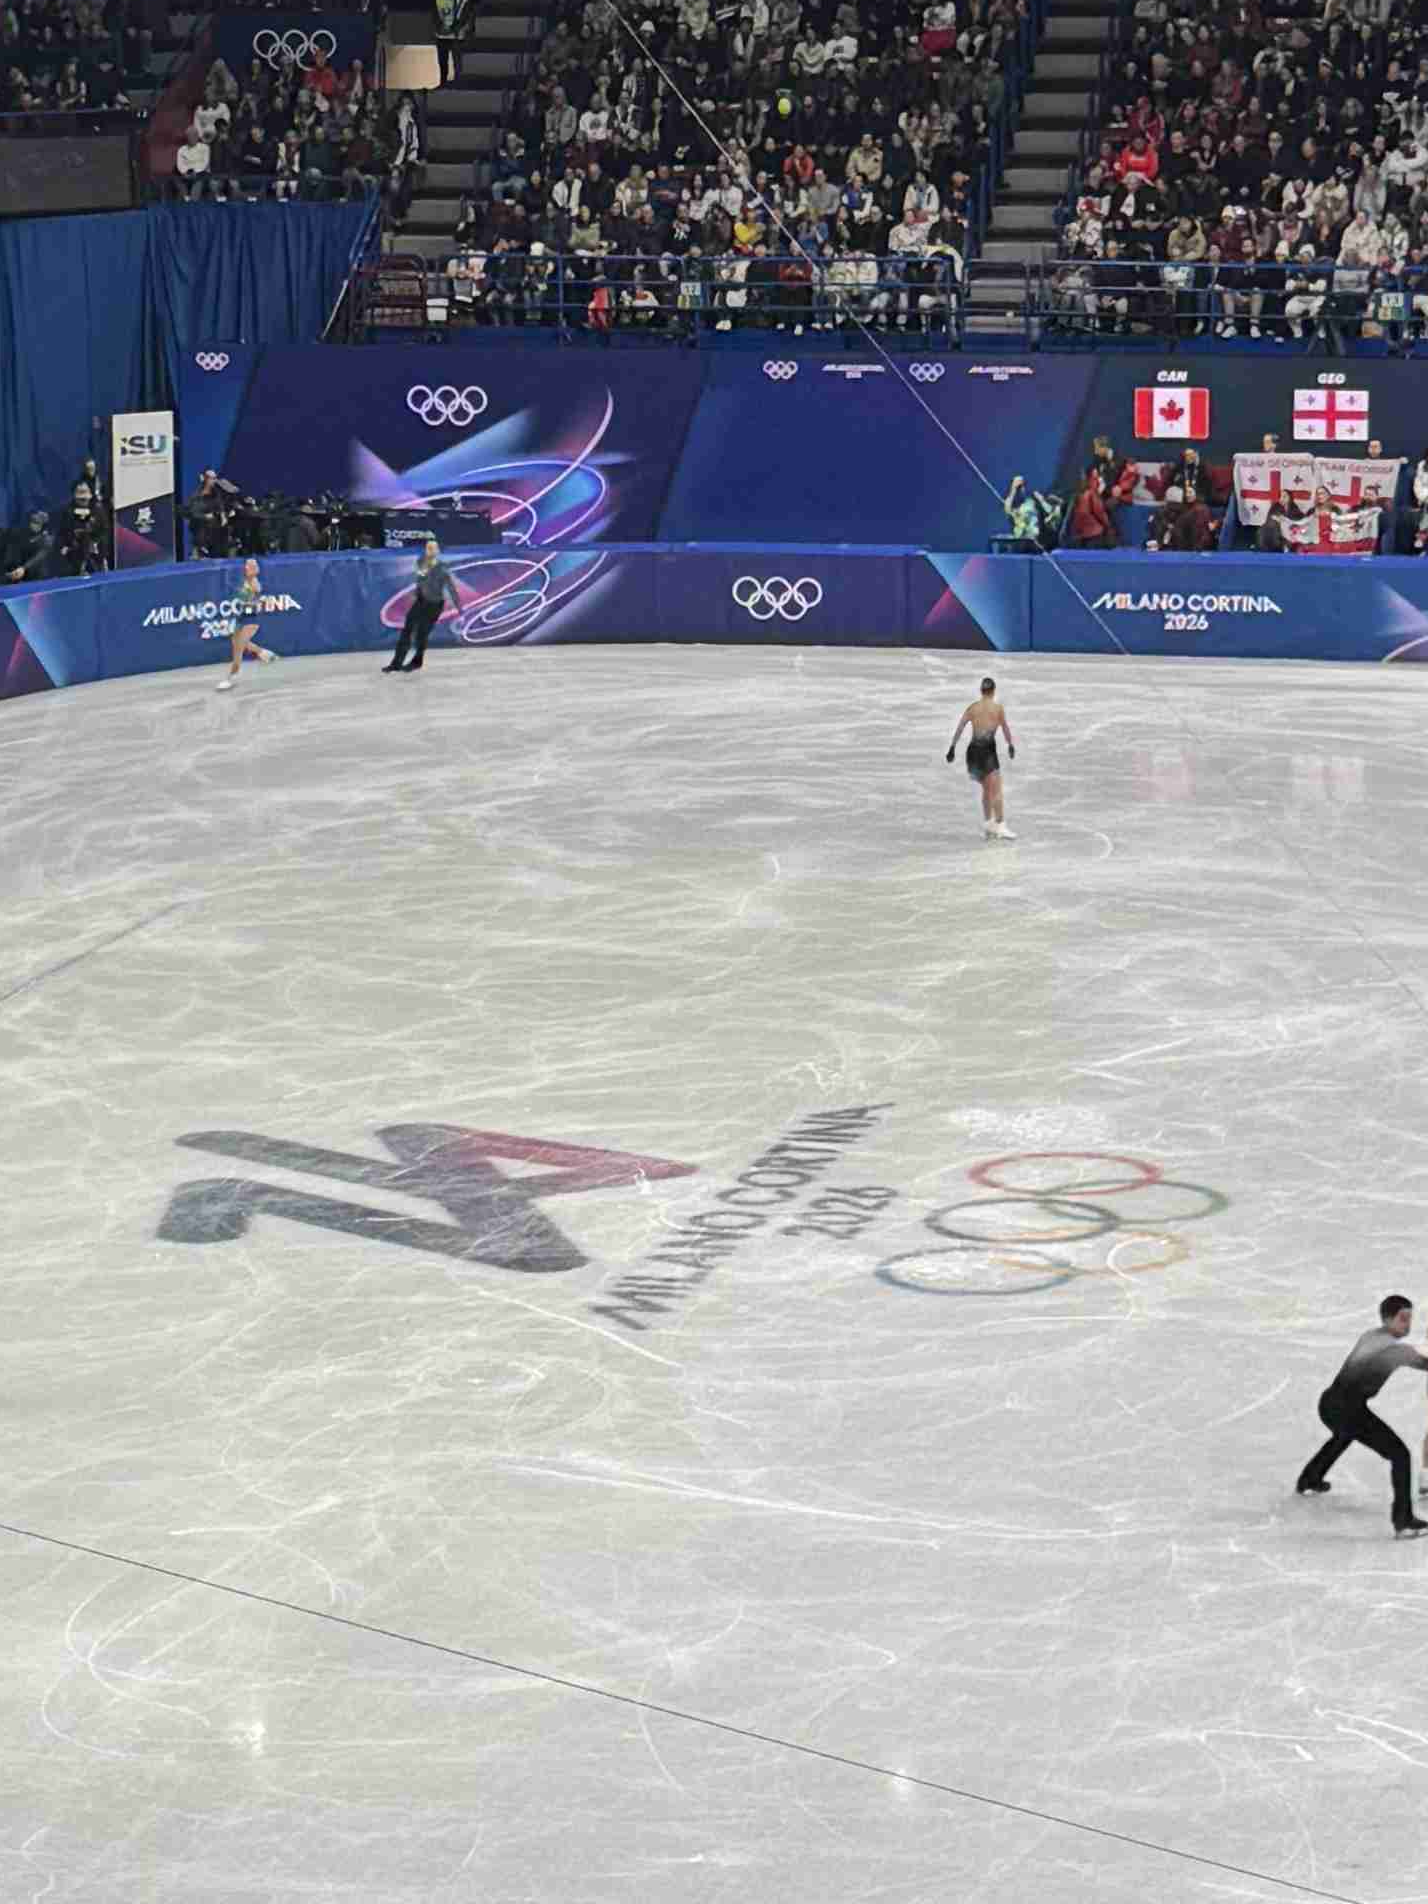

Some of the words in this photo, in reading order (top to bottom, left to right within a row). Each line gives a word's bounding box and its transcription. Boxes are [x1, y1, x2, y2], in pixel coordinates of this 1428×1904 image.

[1156, 370, 1188, 382] CAN
[1317, 372, 1346, 384] GEO
[143, 600, 218, 627] MILANO
[1092, 592, 1184, 612] MILANO
[1187, 593, 1283, 614] CORTINA
[1163, 612, 1210, 631] 2026
[588, 1209, 767, 1332] MILANO
[716, 1102, 897, 1207] CORTINA
[778, 1185, 898, 1241] 2026
